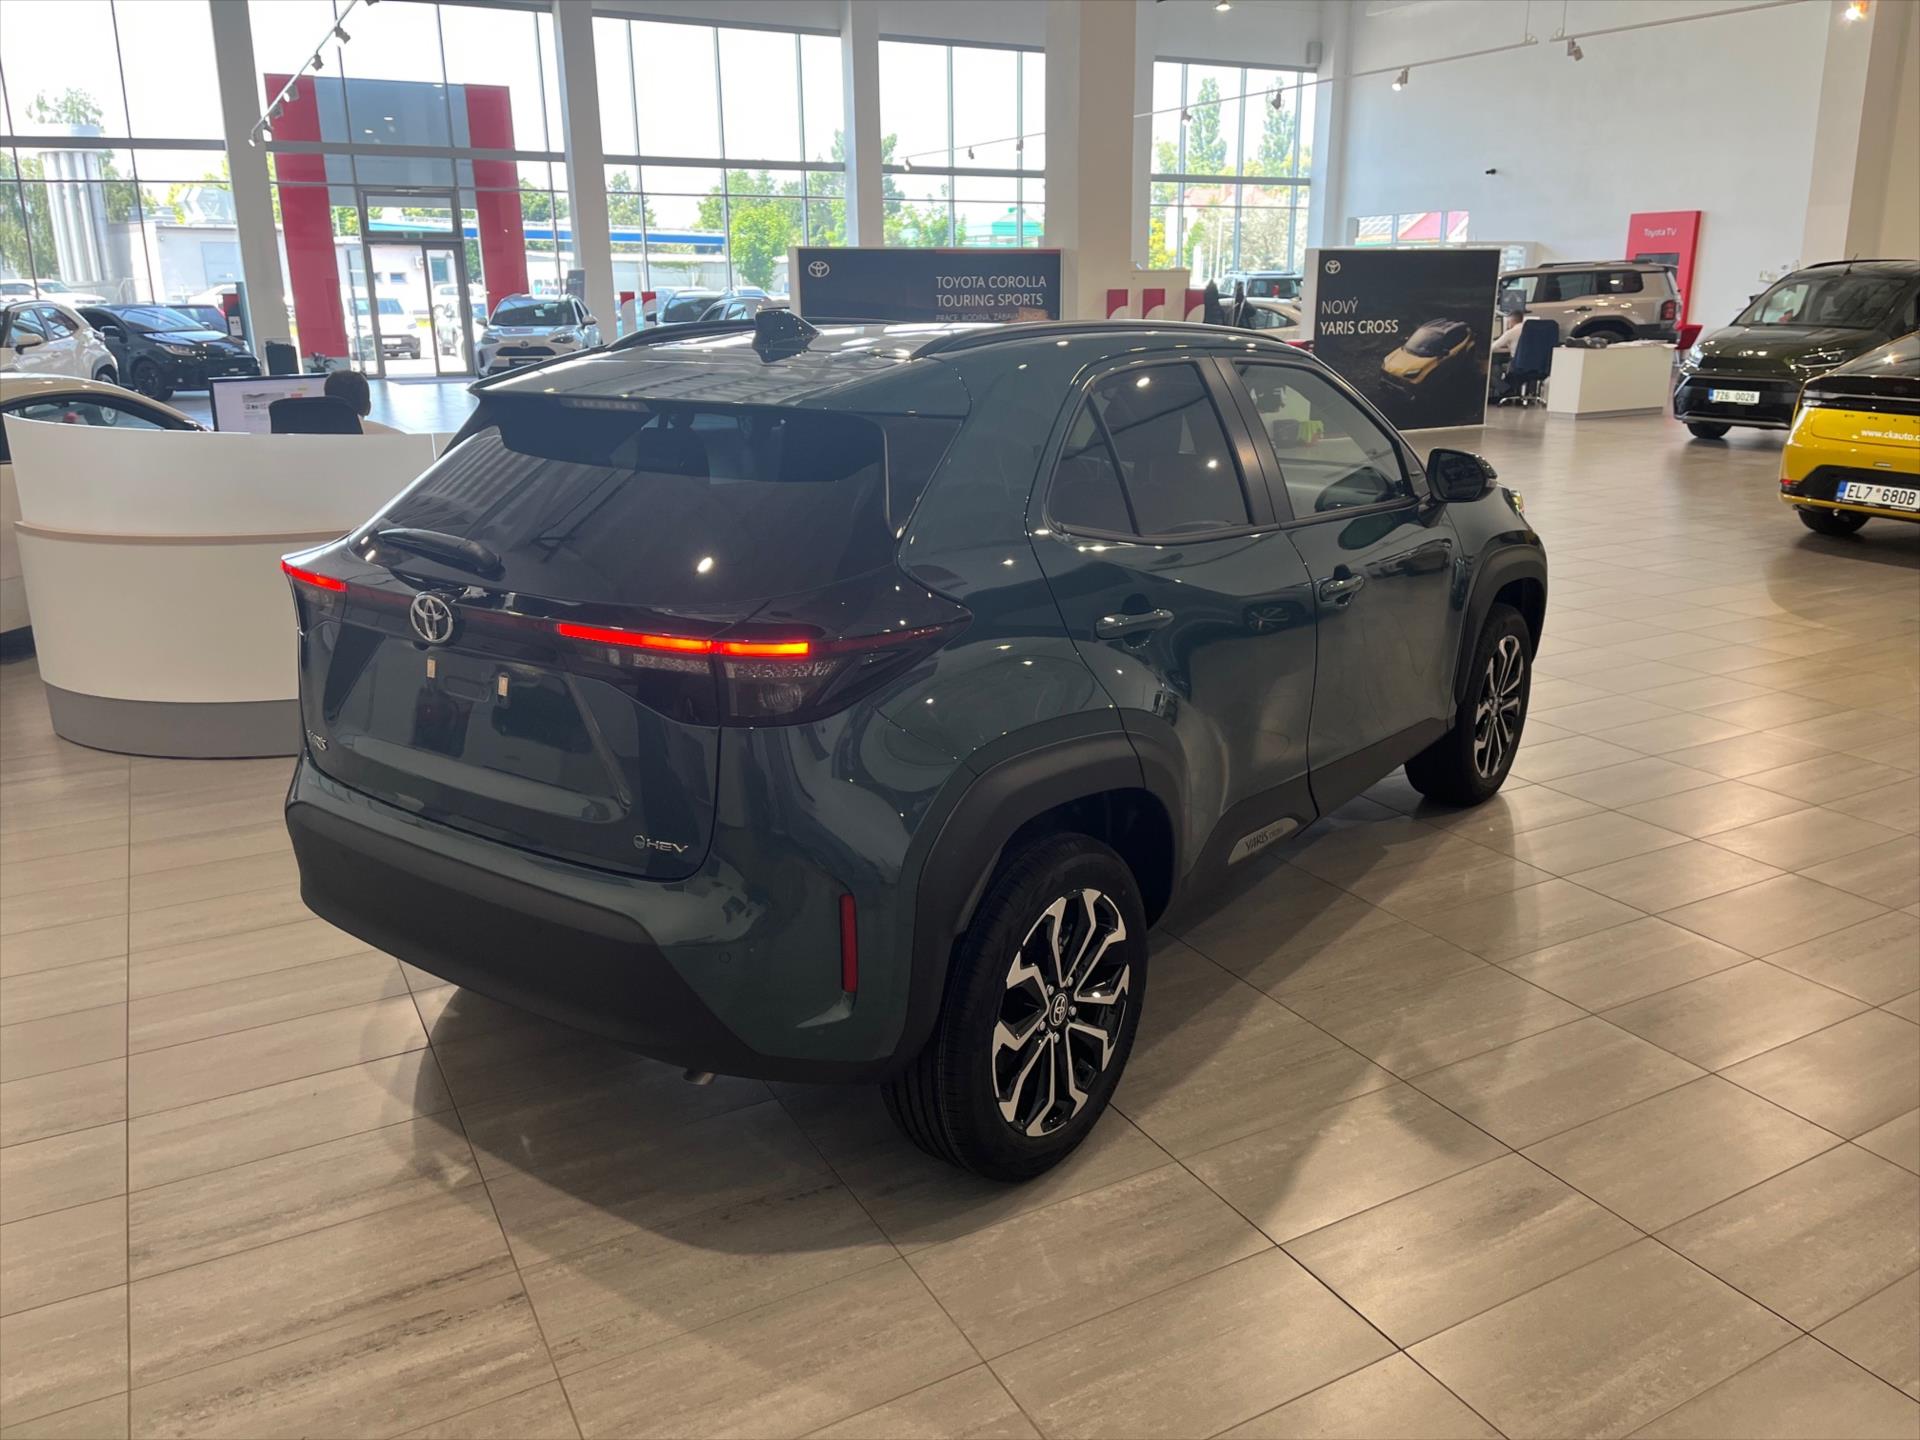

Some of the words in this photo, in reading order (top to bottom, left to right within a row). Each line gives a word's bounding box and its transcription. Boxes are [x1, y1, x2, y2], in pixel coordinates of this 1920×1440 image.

[1644, 228, 1665, 239] Toyota
[1666, 227, 1677, 236] TV
[936, 276, 986, 289] TOYOTA
[988, 275, 1047, 288] COROLLA
[936, 294, 994, 307] TOURING
[997, 293, 1044, 306] SPORTS
[1322, 296, 1358, 314] NOVÝ
[1320, 321, 1355, 335] YARIS
[1358, 320, 1399, 334] CROSS
[1847, 485, 1873, 499] EL7
